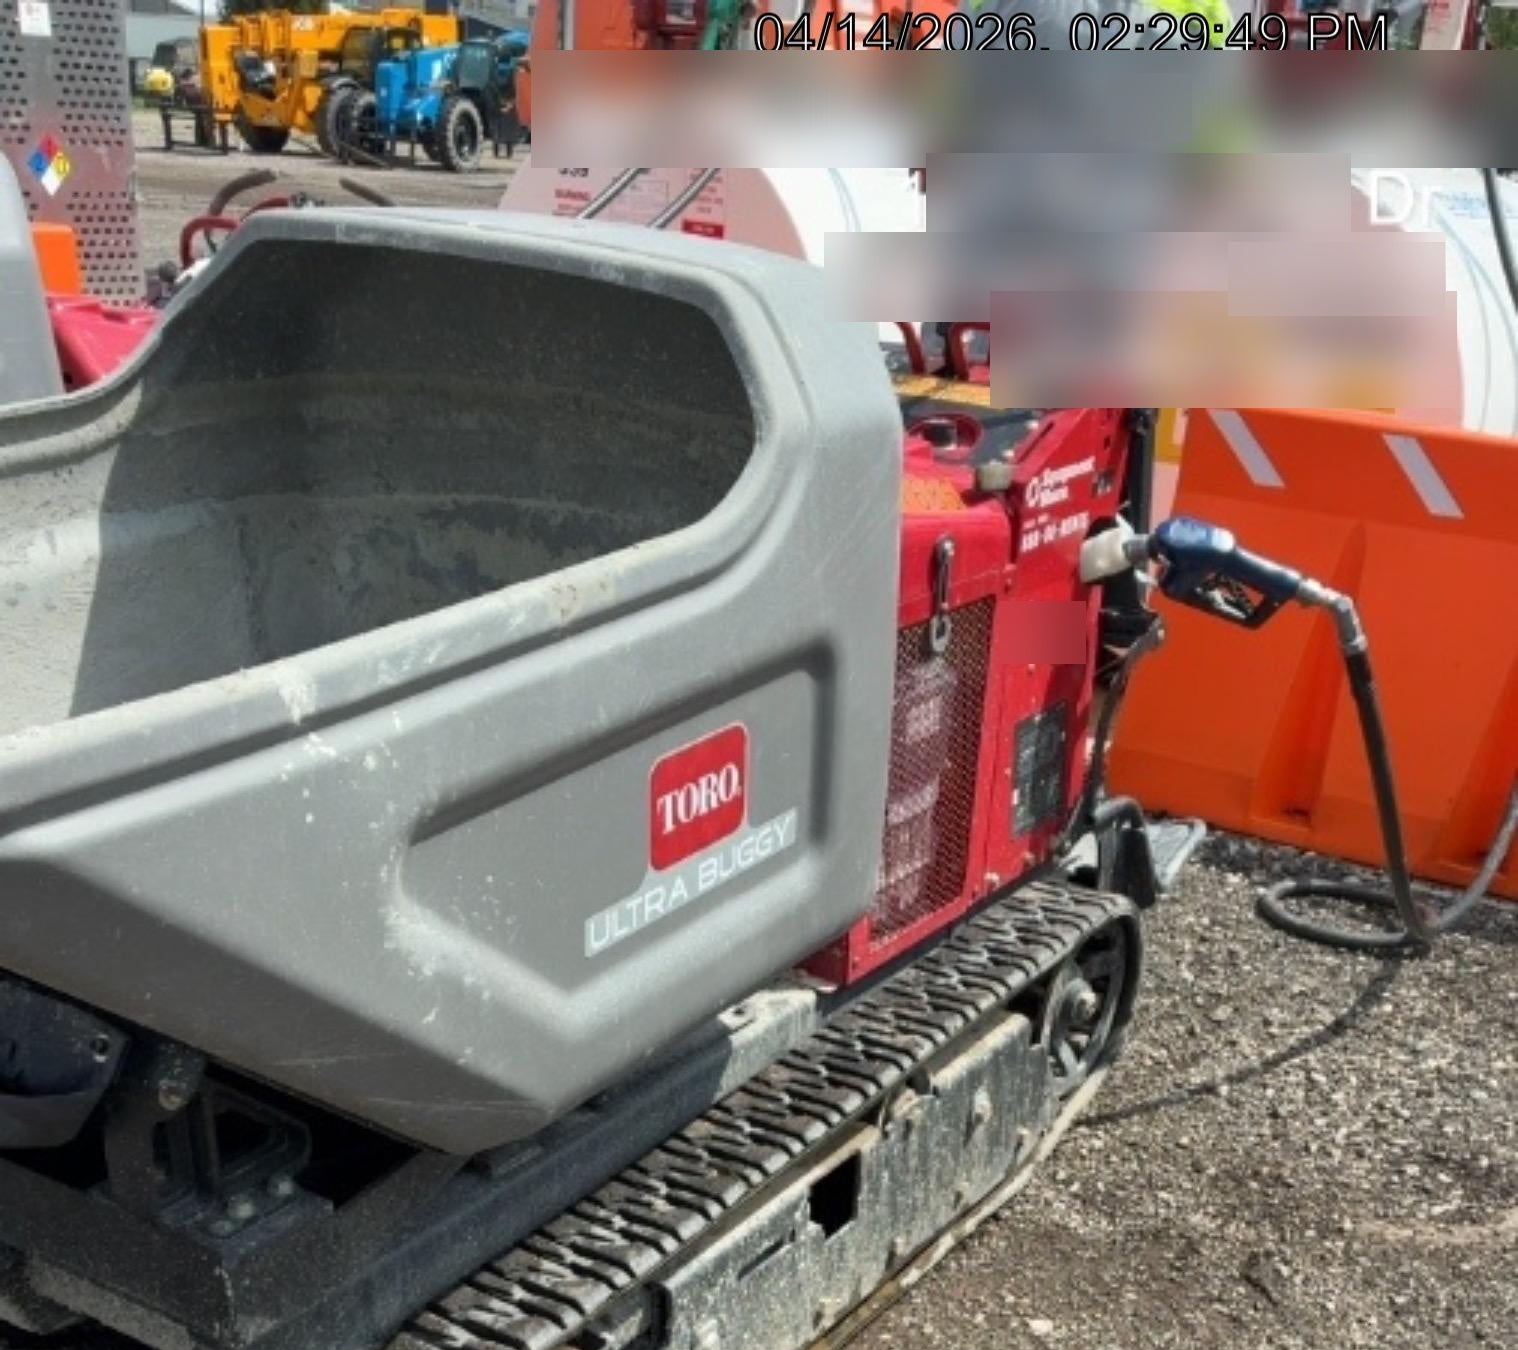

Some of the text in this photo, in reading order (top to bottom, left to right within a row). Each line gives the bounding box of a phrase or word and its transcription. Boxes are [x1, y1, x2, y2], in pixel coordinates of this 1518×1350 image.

[656, 763, 741, 835] TORO
[589, 814, 791, 949] ULTRA BUGGY
